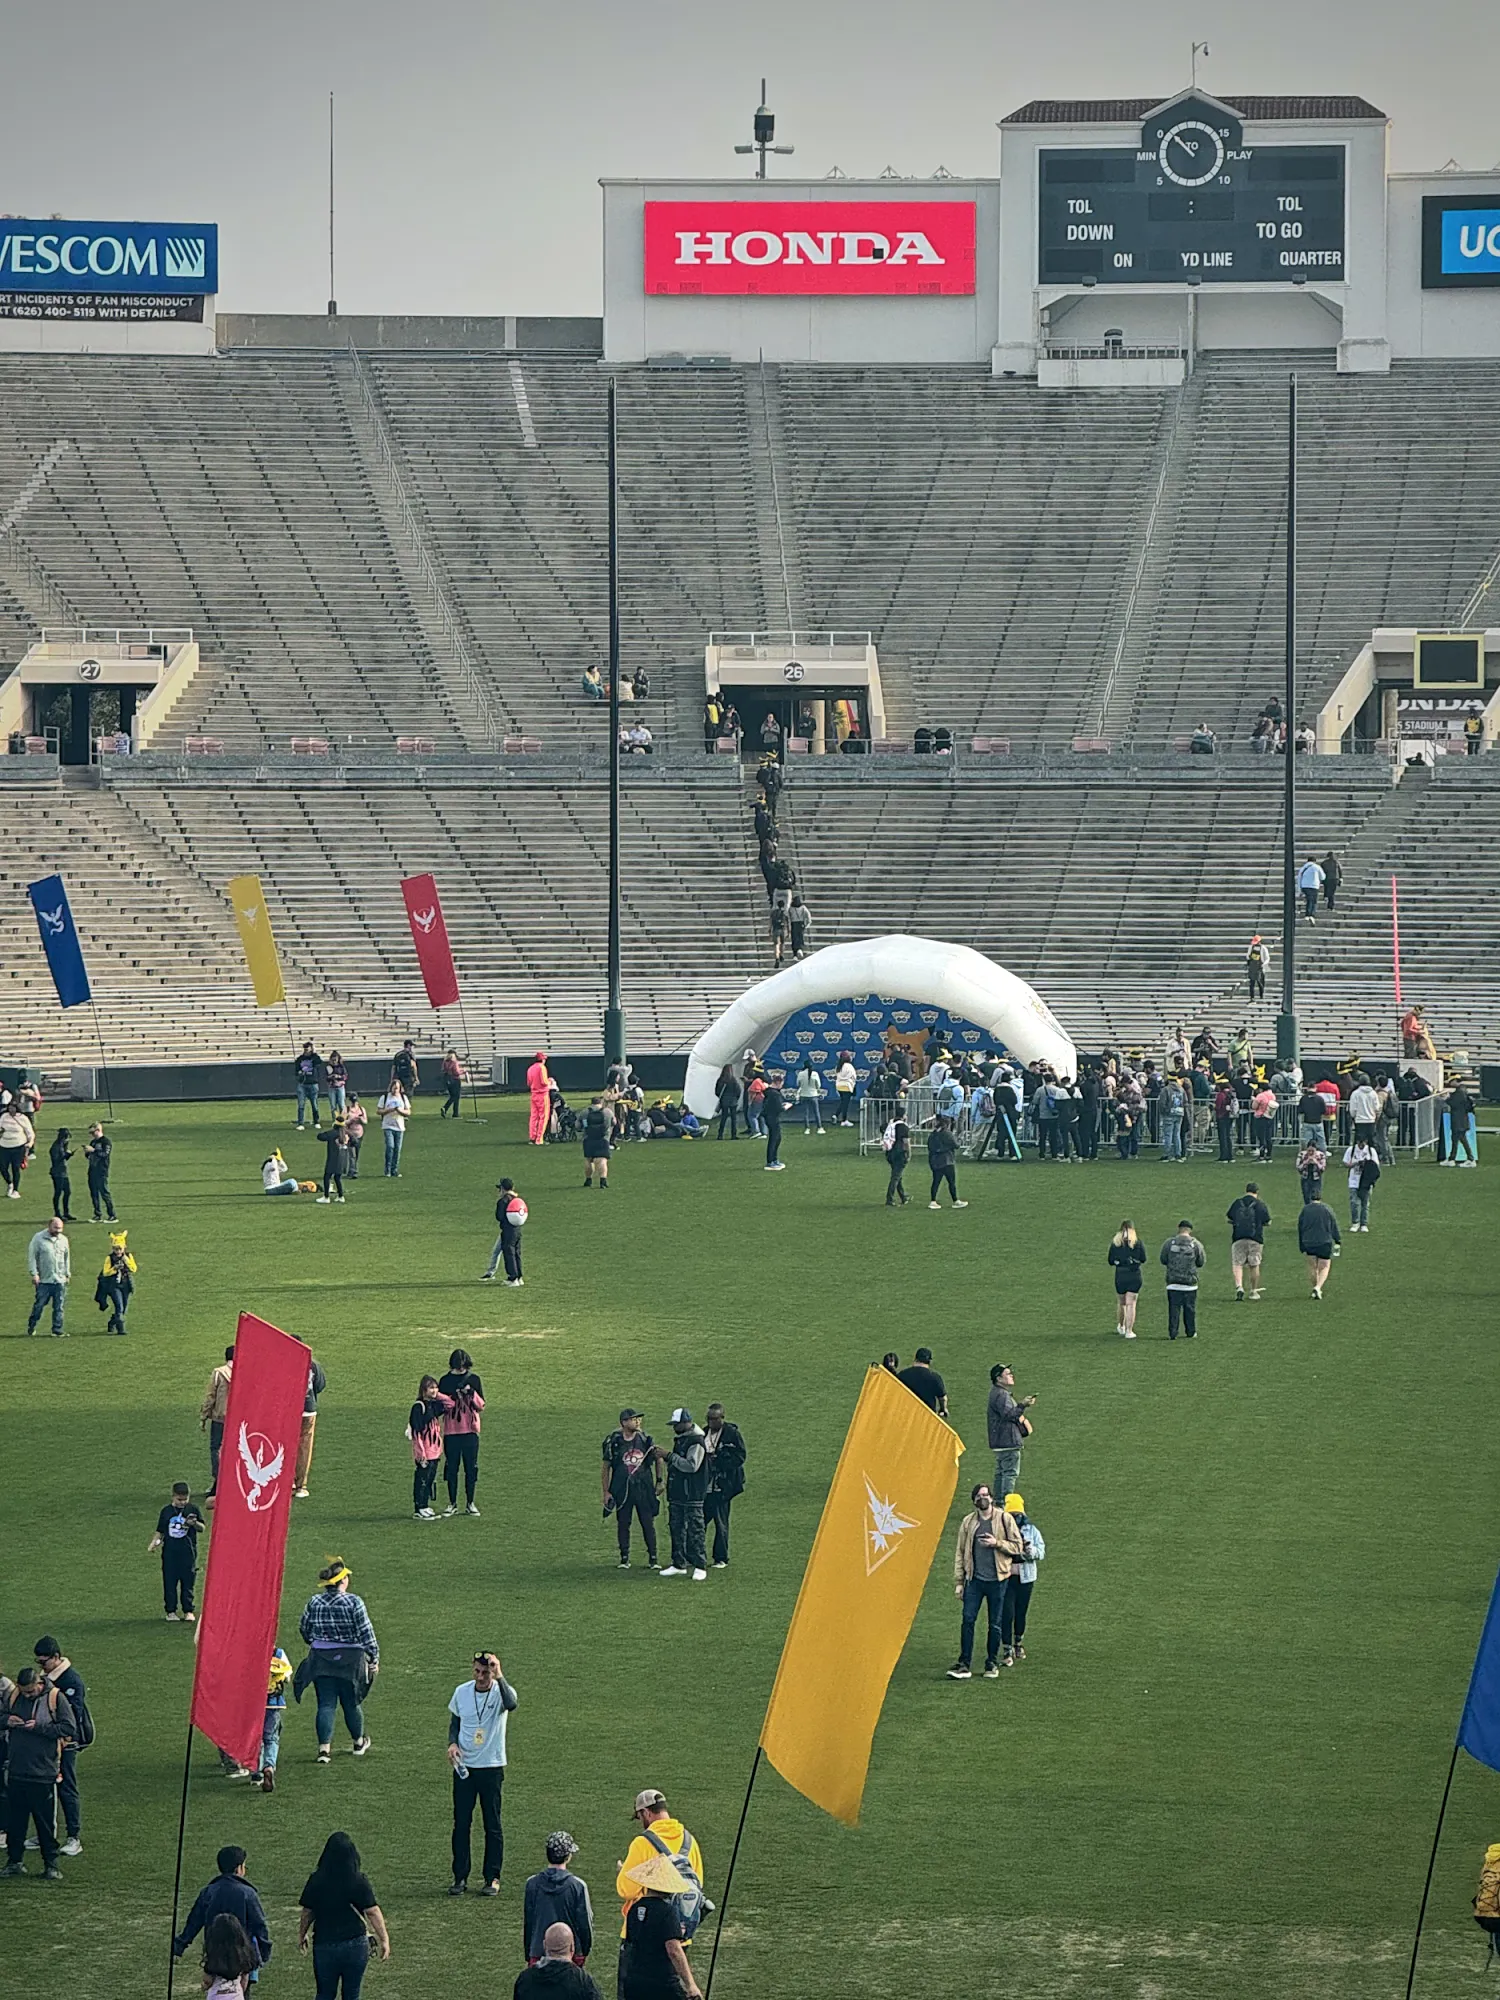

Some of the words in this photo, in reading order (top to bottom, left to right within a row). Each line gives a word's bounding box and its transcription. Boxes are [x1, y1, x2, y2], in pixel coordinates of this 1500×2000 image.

[1218, 128, 1230, 138] 15
[1186, 141, 1199, 150] TO
[1136, 151, 1157, 161] MIN
[1226, 150, 1253, 160] PLAY
[1156, 176, 1164, 186] 5
[1218, 175, 1231, 185] 10
[1067, 199, 1093, 214] TOL
[1276, 196, 1303, 212] TOL
[1067, 224, 1114, 241] DOWN
[1256, 223, 1276, 239] TO
[1280, 222, 1303, 239] GO
[674, 231, 946, 265] HONDA
[1113, 253, 1133, 268] ON
[1180, 253, 1200, 268] YD
[1203, 252, 1233, 267] LINE
[1279, 250, 1342, 267] QUARTER
[15, 294, 74, 305] INCIDENTS
[76, 296, 92, 305] OF
[95, 296, 118, 306] FAN
[121, 296, 194, 307] MISCONDUCT
[12, 306, 42, 316] (626)
[73, 307, 95, 317] 5119
[98, 308, 127, 318] WITH
[130, 309, 176, 317] DETAILS
[81, 664, 100, 676] 27
[785, 666, 803, 678] 26
[1405, 720, 1444, 730] STADIUM
